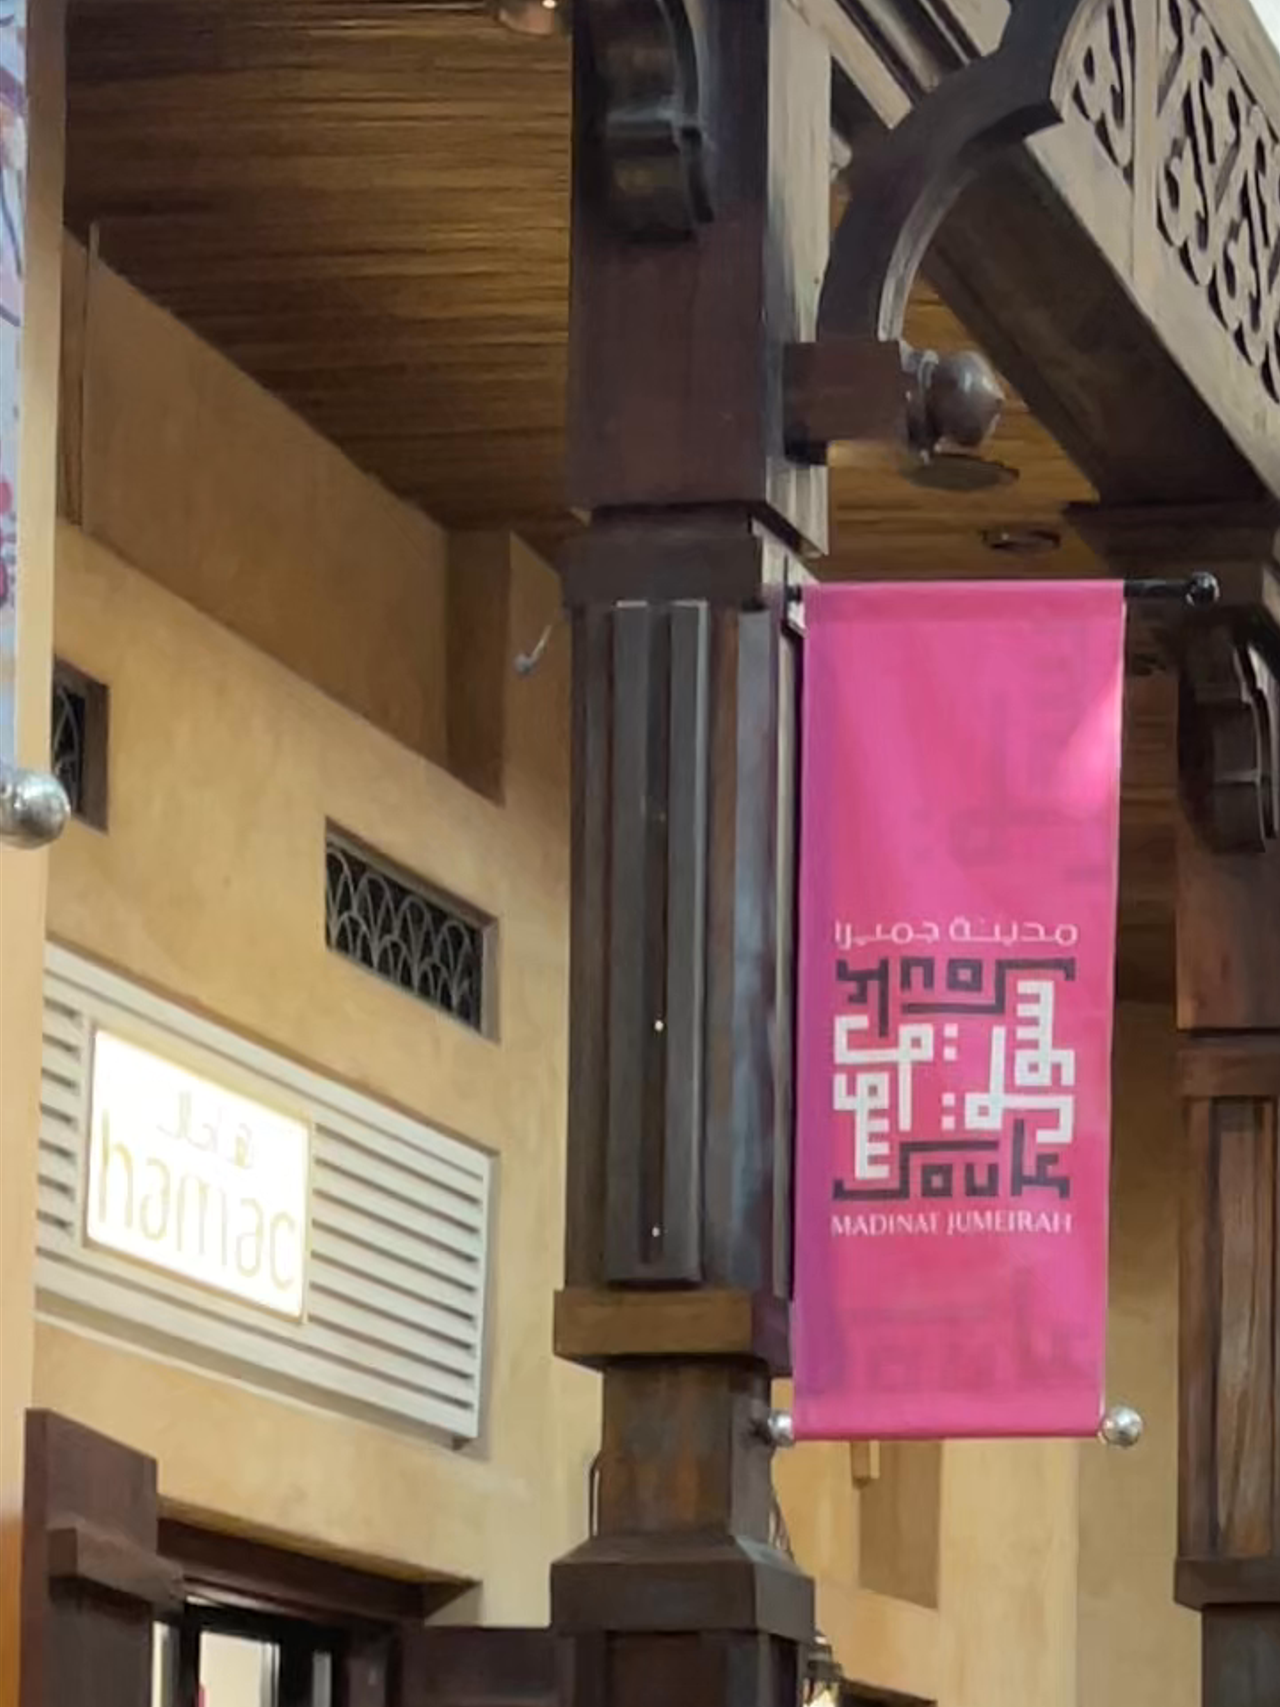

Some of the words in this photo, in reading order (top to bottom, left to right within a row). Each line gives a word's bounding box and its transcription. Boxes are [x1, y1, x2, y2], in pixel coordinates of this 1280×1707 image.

[97, 1106, 297, 1291] hamac
[830, 1213, 940, 1236] MADINAT
[946, 1210, 1073, 1235] JUMEIRAH
